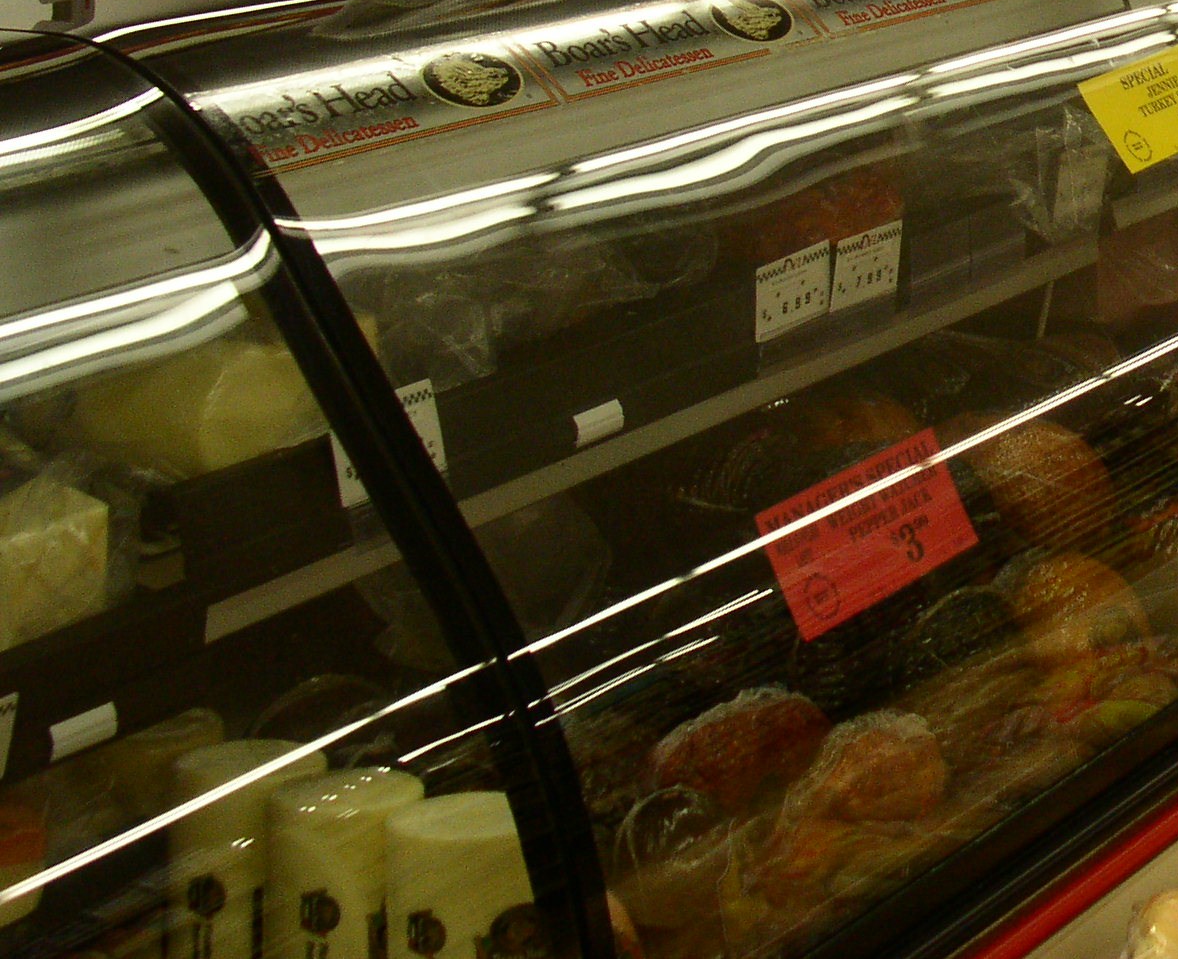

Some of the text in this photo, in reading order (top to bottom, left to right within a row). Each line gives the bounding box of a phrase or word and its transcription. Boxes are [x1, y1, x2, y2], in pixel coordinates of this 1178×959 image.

[835, 7, 868, 26] Fine
[531, 10, 709, 70] Boar's Head
[576, 45, 715, 87] Fine Delicatessen
[1119, 62, 1169, 90] SPECIAL
[239, 70, 417, 135] oar's Head
[1138, 94, 1177, 118] TURKEY
[295, 114, 420, 156] Delicatessen
